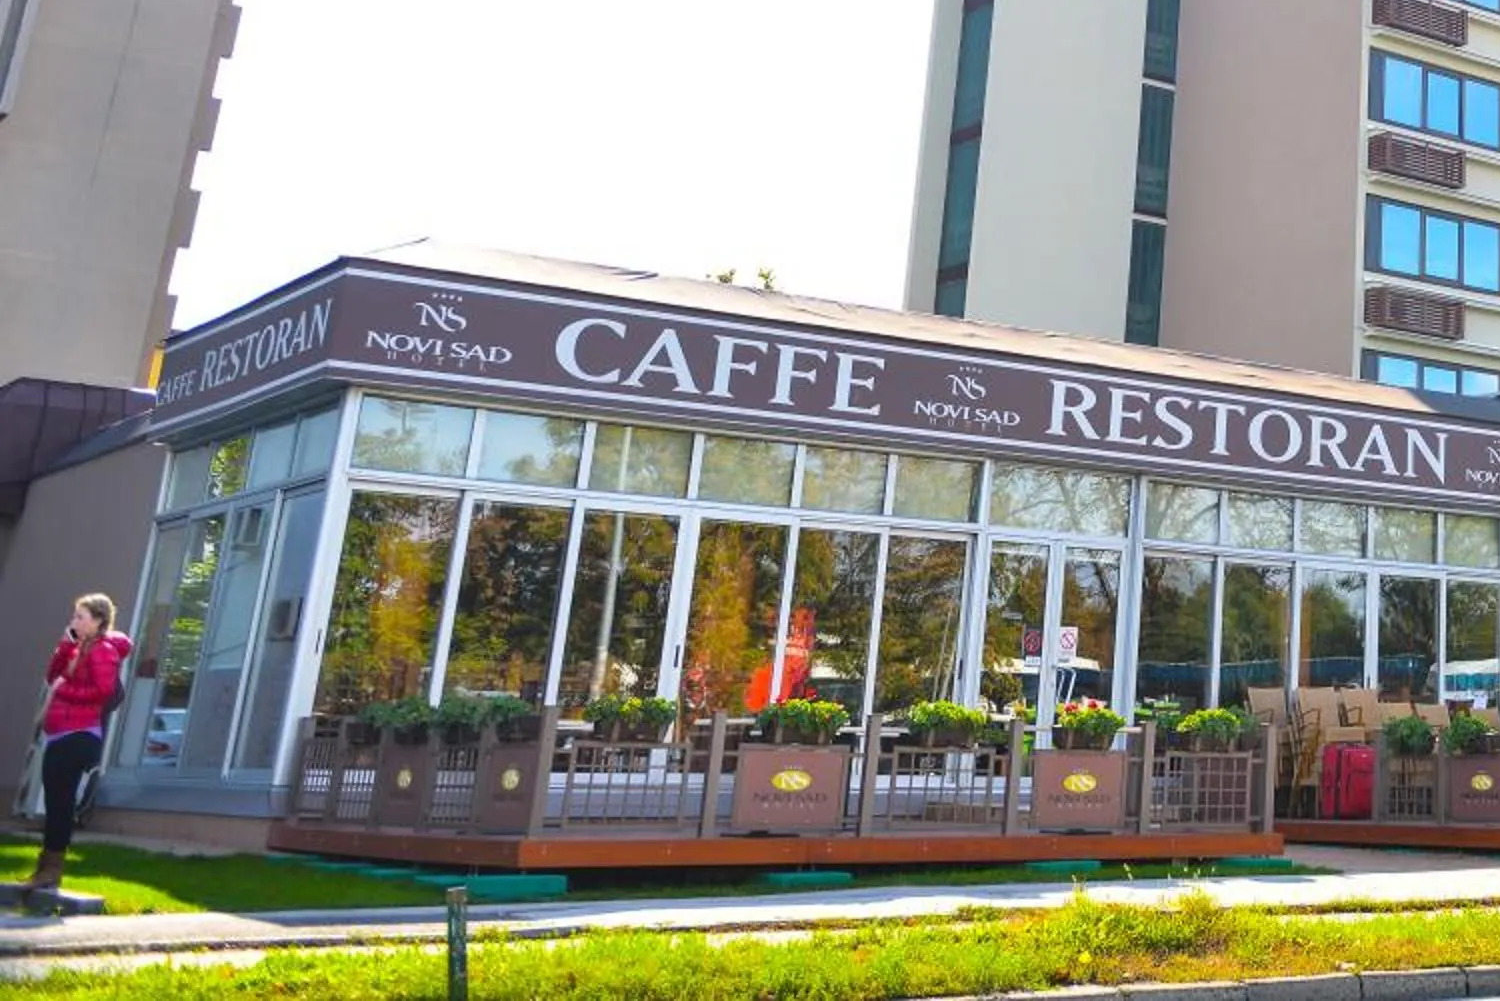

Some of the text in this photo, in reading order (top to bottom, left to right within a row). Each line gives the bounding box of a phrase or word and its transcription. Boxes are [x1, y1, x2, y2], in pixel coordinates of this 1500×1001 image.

[156, 299, 333, 407] CAFFE RESTORAN
[366, 330, 513, 364] NOVI SAD
[555, 318, 886, 417] CAFFE
[913, 400, 1021, 426] NOVI SAD
[1045, 379, 1449, 486] RESTORAN
